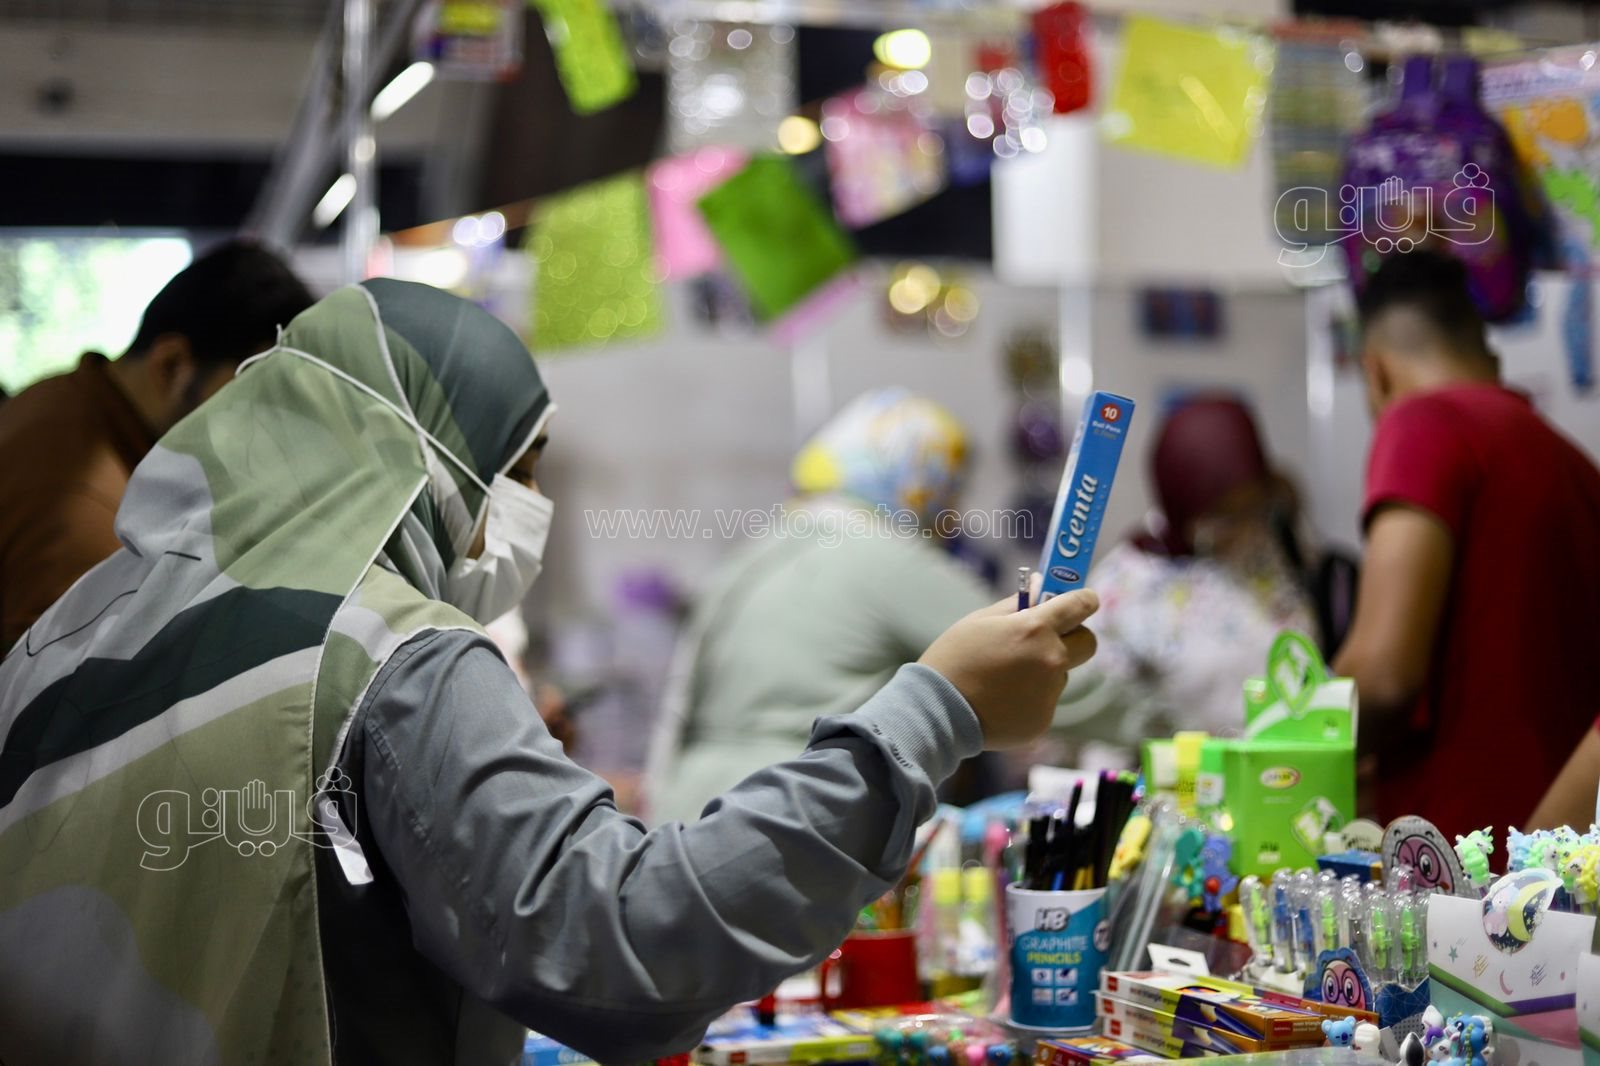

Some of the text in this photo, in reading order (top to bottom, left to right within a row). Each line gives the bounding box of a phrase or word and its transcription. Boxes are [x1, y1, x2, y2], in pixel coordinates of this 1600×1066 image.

[1104, 406, 1118, 420] 10
[1057, 473, 1098, 558] Genta
[1035, 907, 1071, 931] HB
[1021, 935, 1088, 951] GRAPHITE
[1026, 951, 1082, 965] PENCILS
